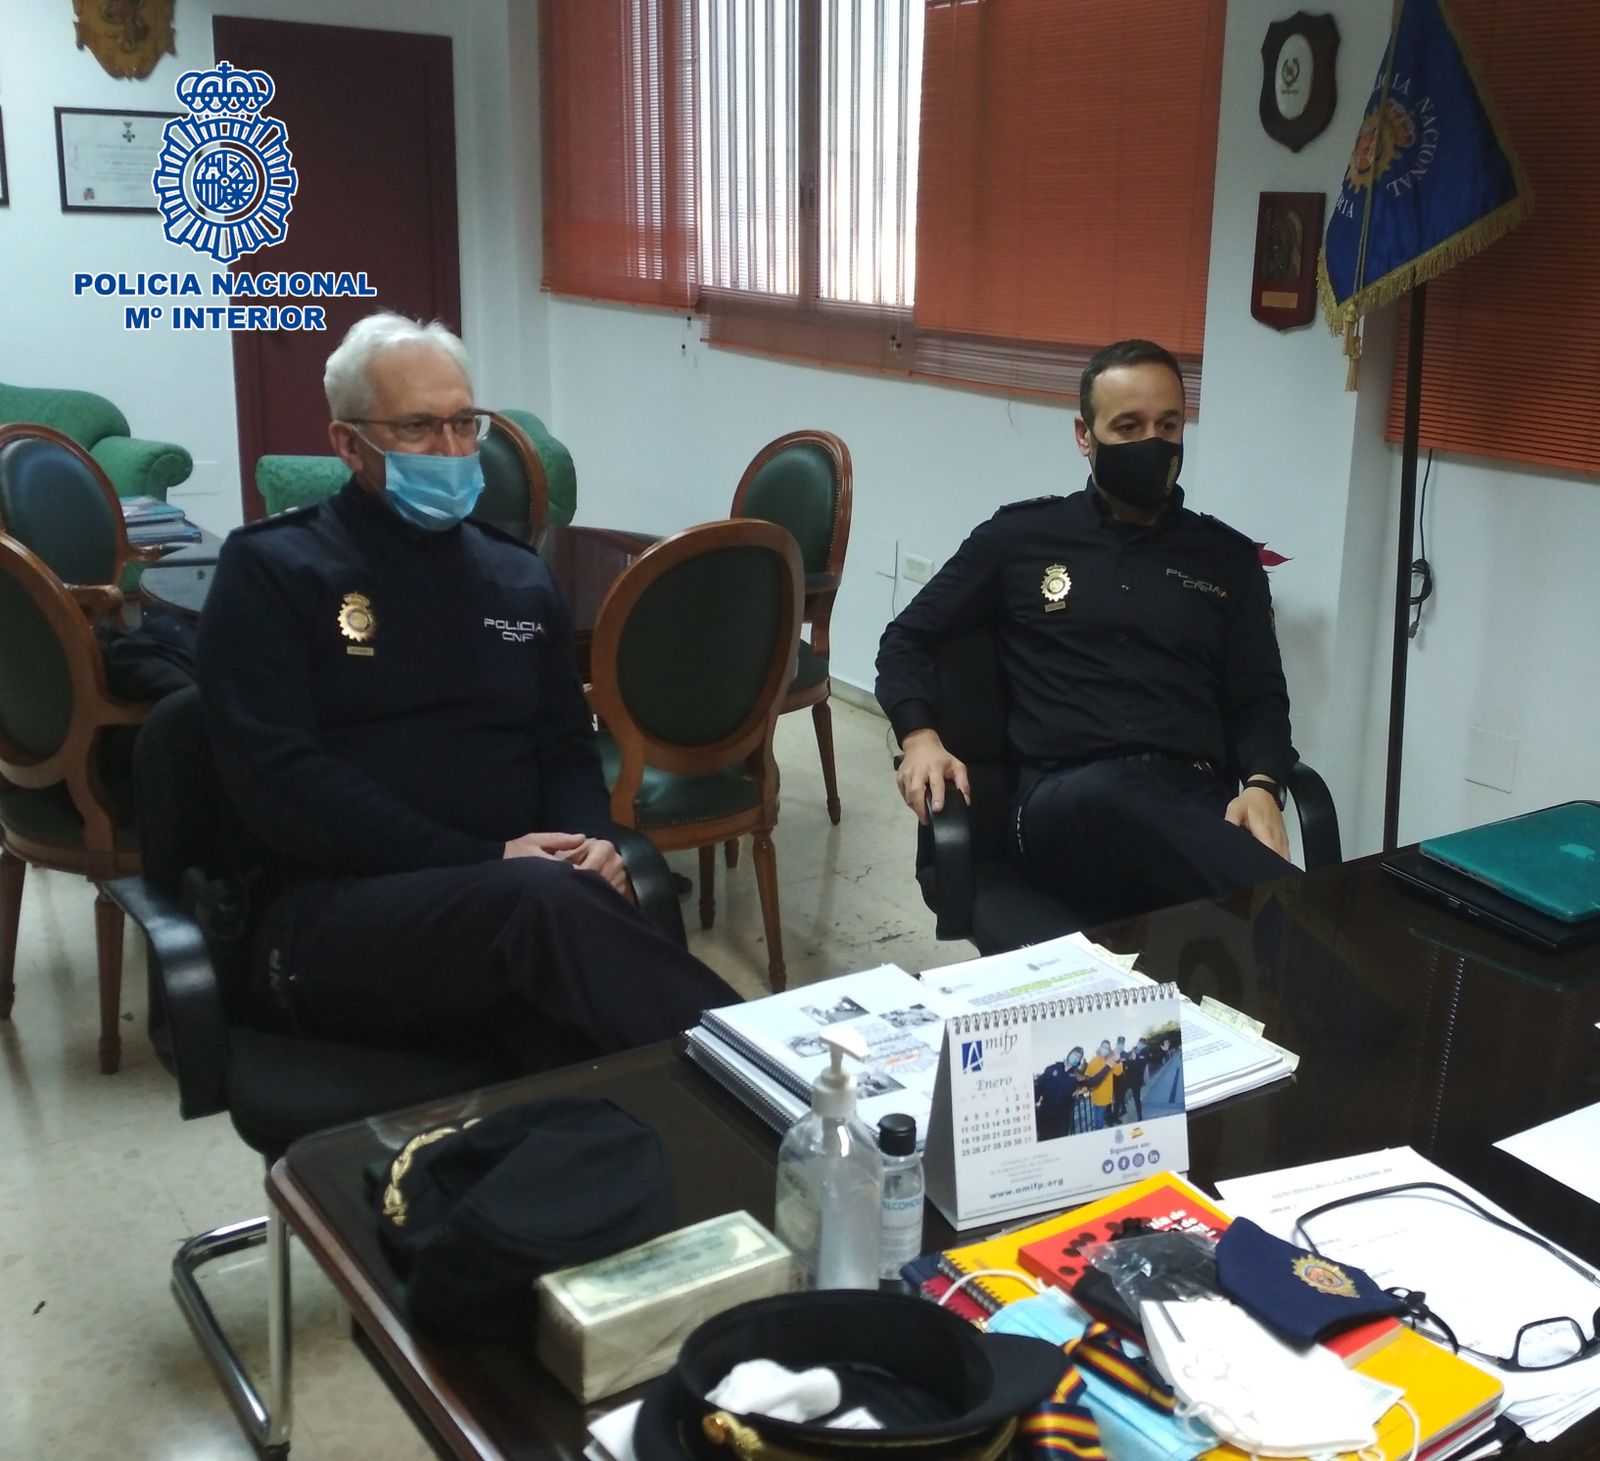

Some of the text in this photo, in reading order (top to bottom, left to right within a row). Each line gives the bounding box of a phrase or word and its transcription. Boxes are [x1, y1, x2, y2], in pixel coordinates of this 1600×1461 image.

[1386, 97, 1439, 197] NACIONAL
[483, 617, 544, 633] POLICIA
[502, 630, 534, 643] CNP
[976, 1076, 1013, 1092] Enero
